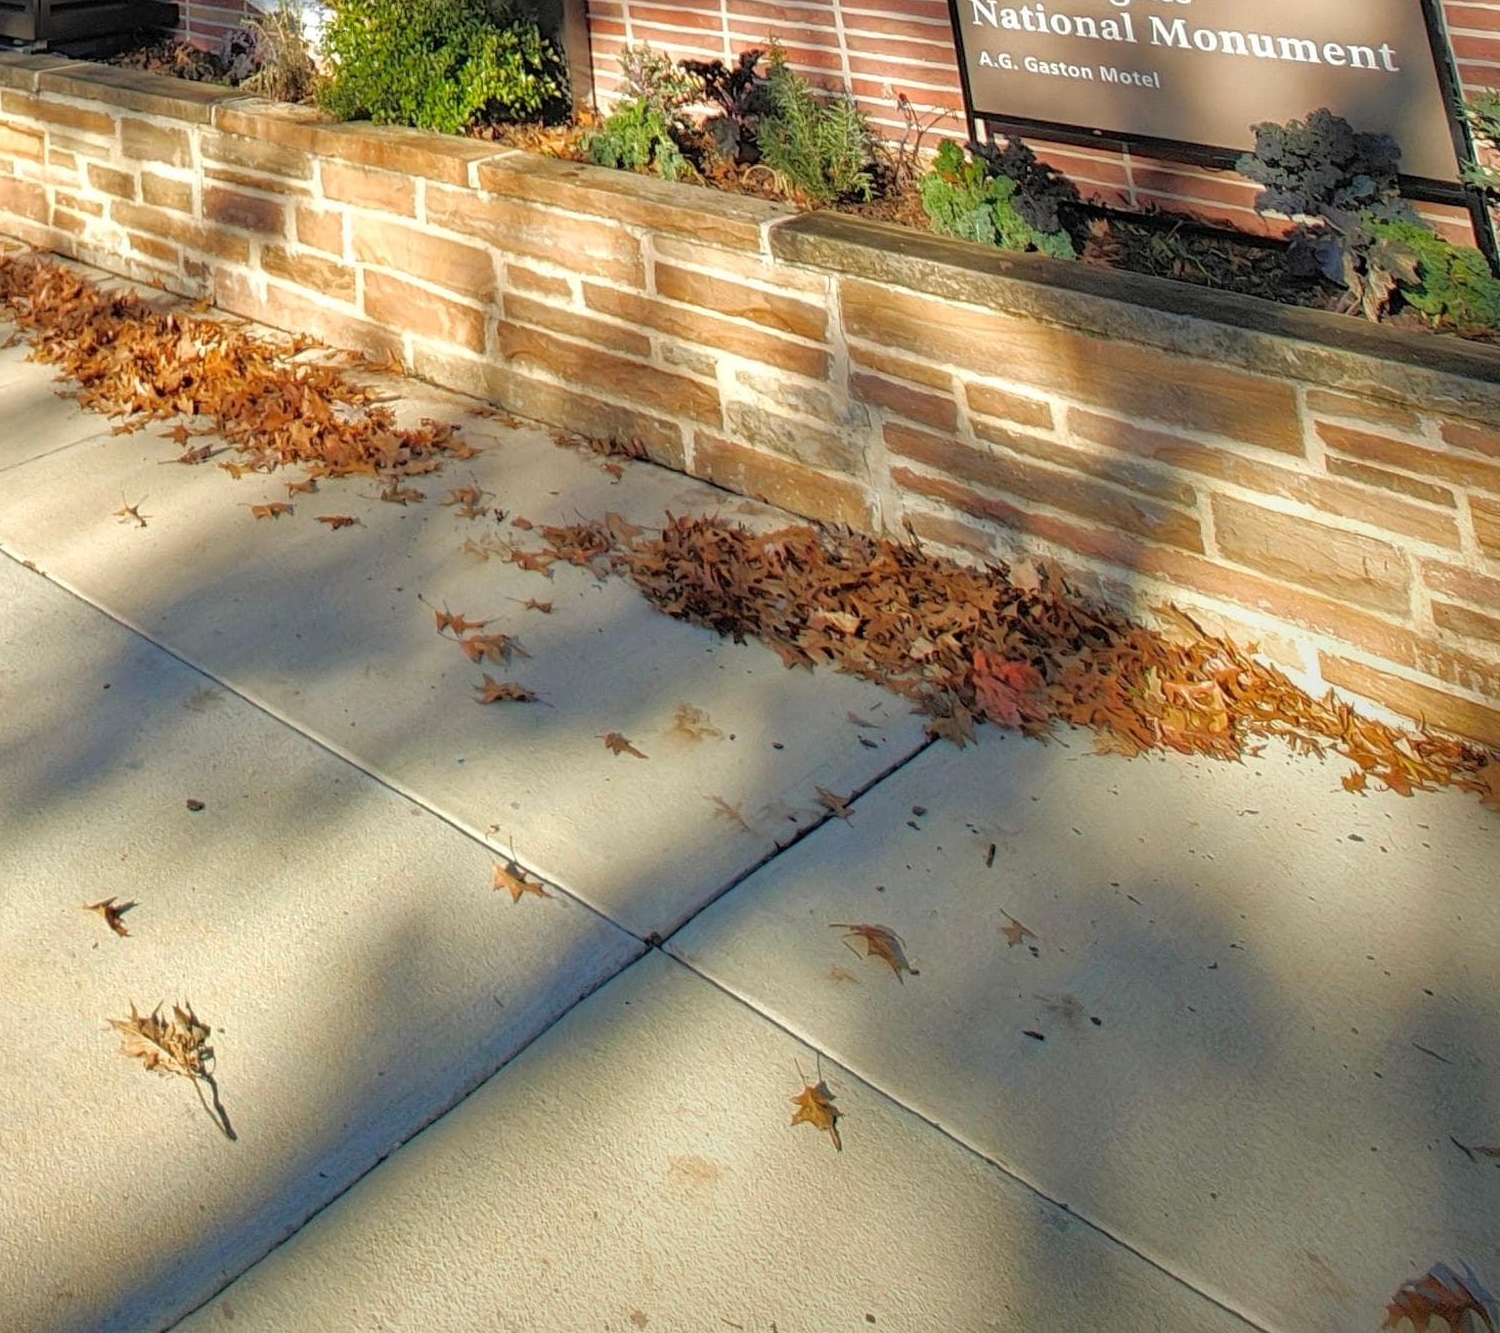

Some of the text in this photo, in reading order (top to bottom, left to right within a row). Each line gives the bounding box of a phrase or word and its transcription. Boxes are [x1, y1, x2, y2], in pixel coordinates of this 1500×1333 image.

[1148, 14, 1400, 73] Monument
[979, 50, 1161, 90] A.G. Gaston Motel
